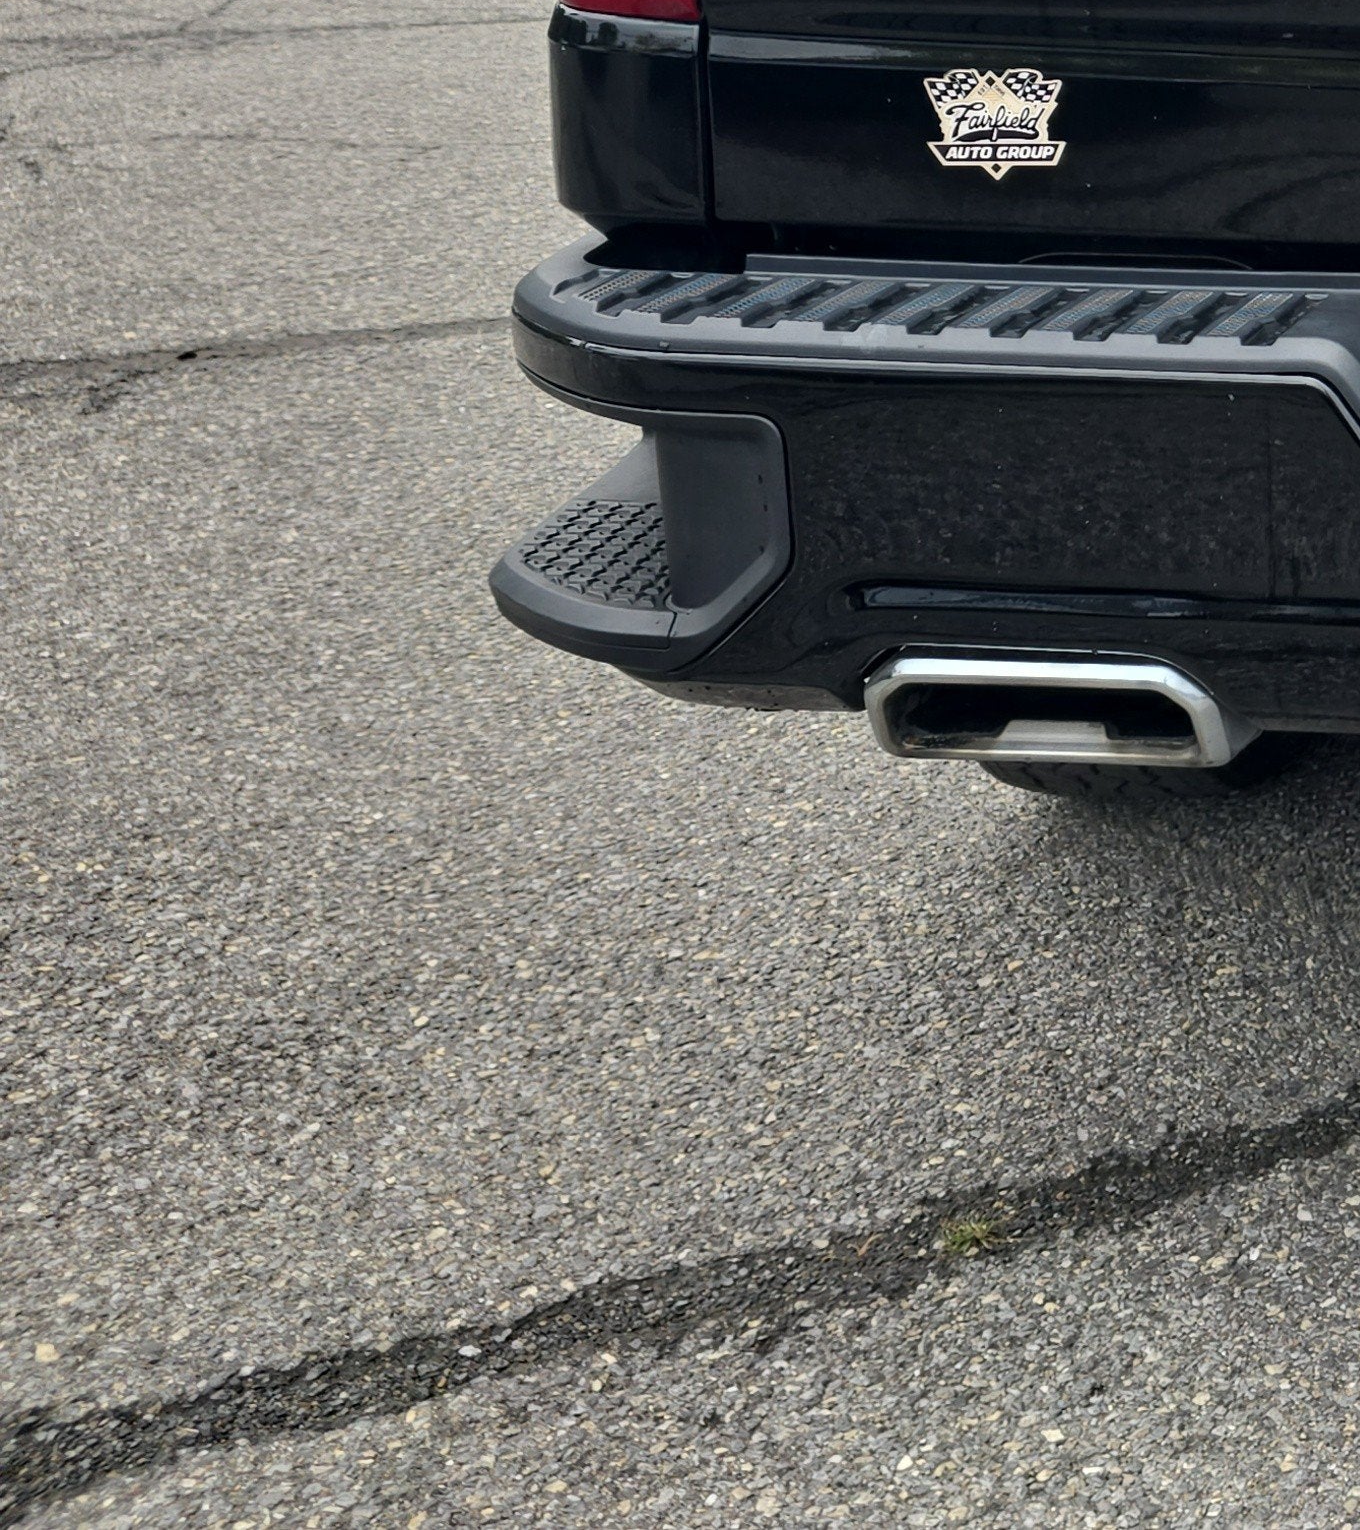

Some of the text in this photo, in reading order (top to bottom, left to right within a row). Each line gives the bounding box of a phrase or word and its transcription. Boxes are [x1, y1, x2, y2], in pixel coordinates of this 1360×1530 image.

[945, 102, 1046, 142] Fairfield
[945, 146, 1056, 160] AUTO GROUP
